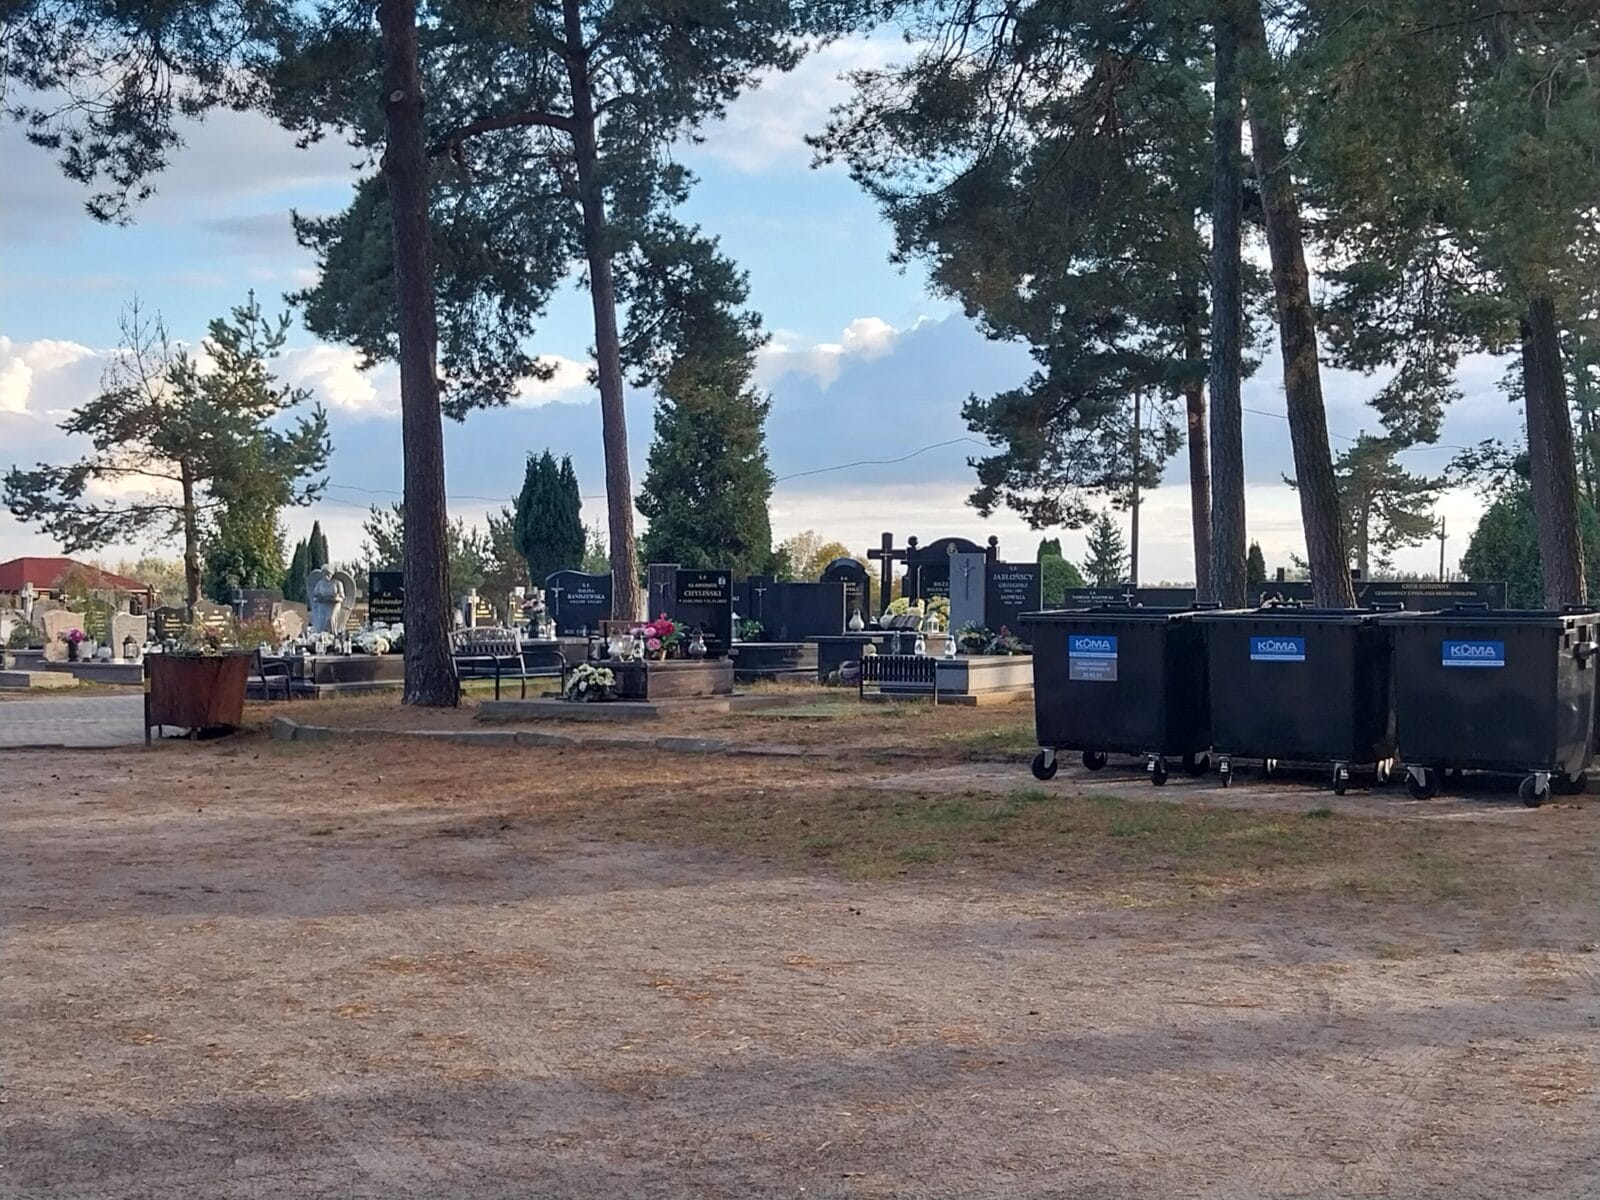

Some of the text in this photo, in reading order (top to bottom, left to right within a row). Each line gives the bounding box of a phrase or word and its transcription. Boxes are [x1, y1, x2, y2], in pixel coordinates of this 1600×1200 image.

[1075, 638, 1111, 650] KOMA
[1257, 639, 1297, 651] KOMA
[1450, 644, 1496, 657] KOMA
